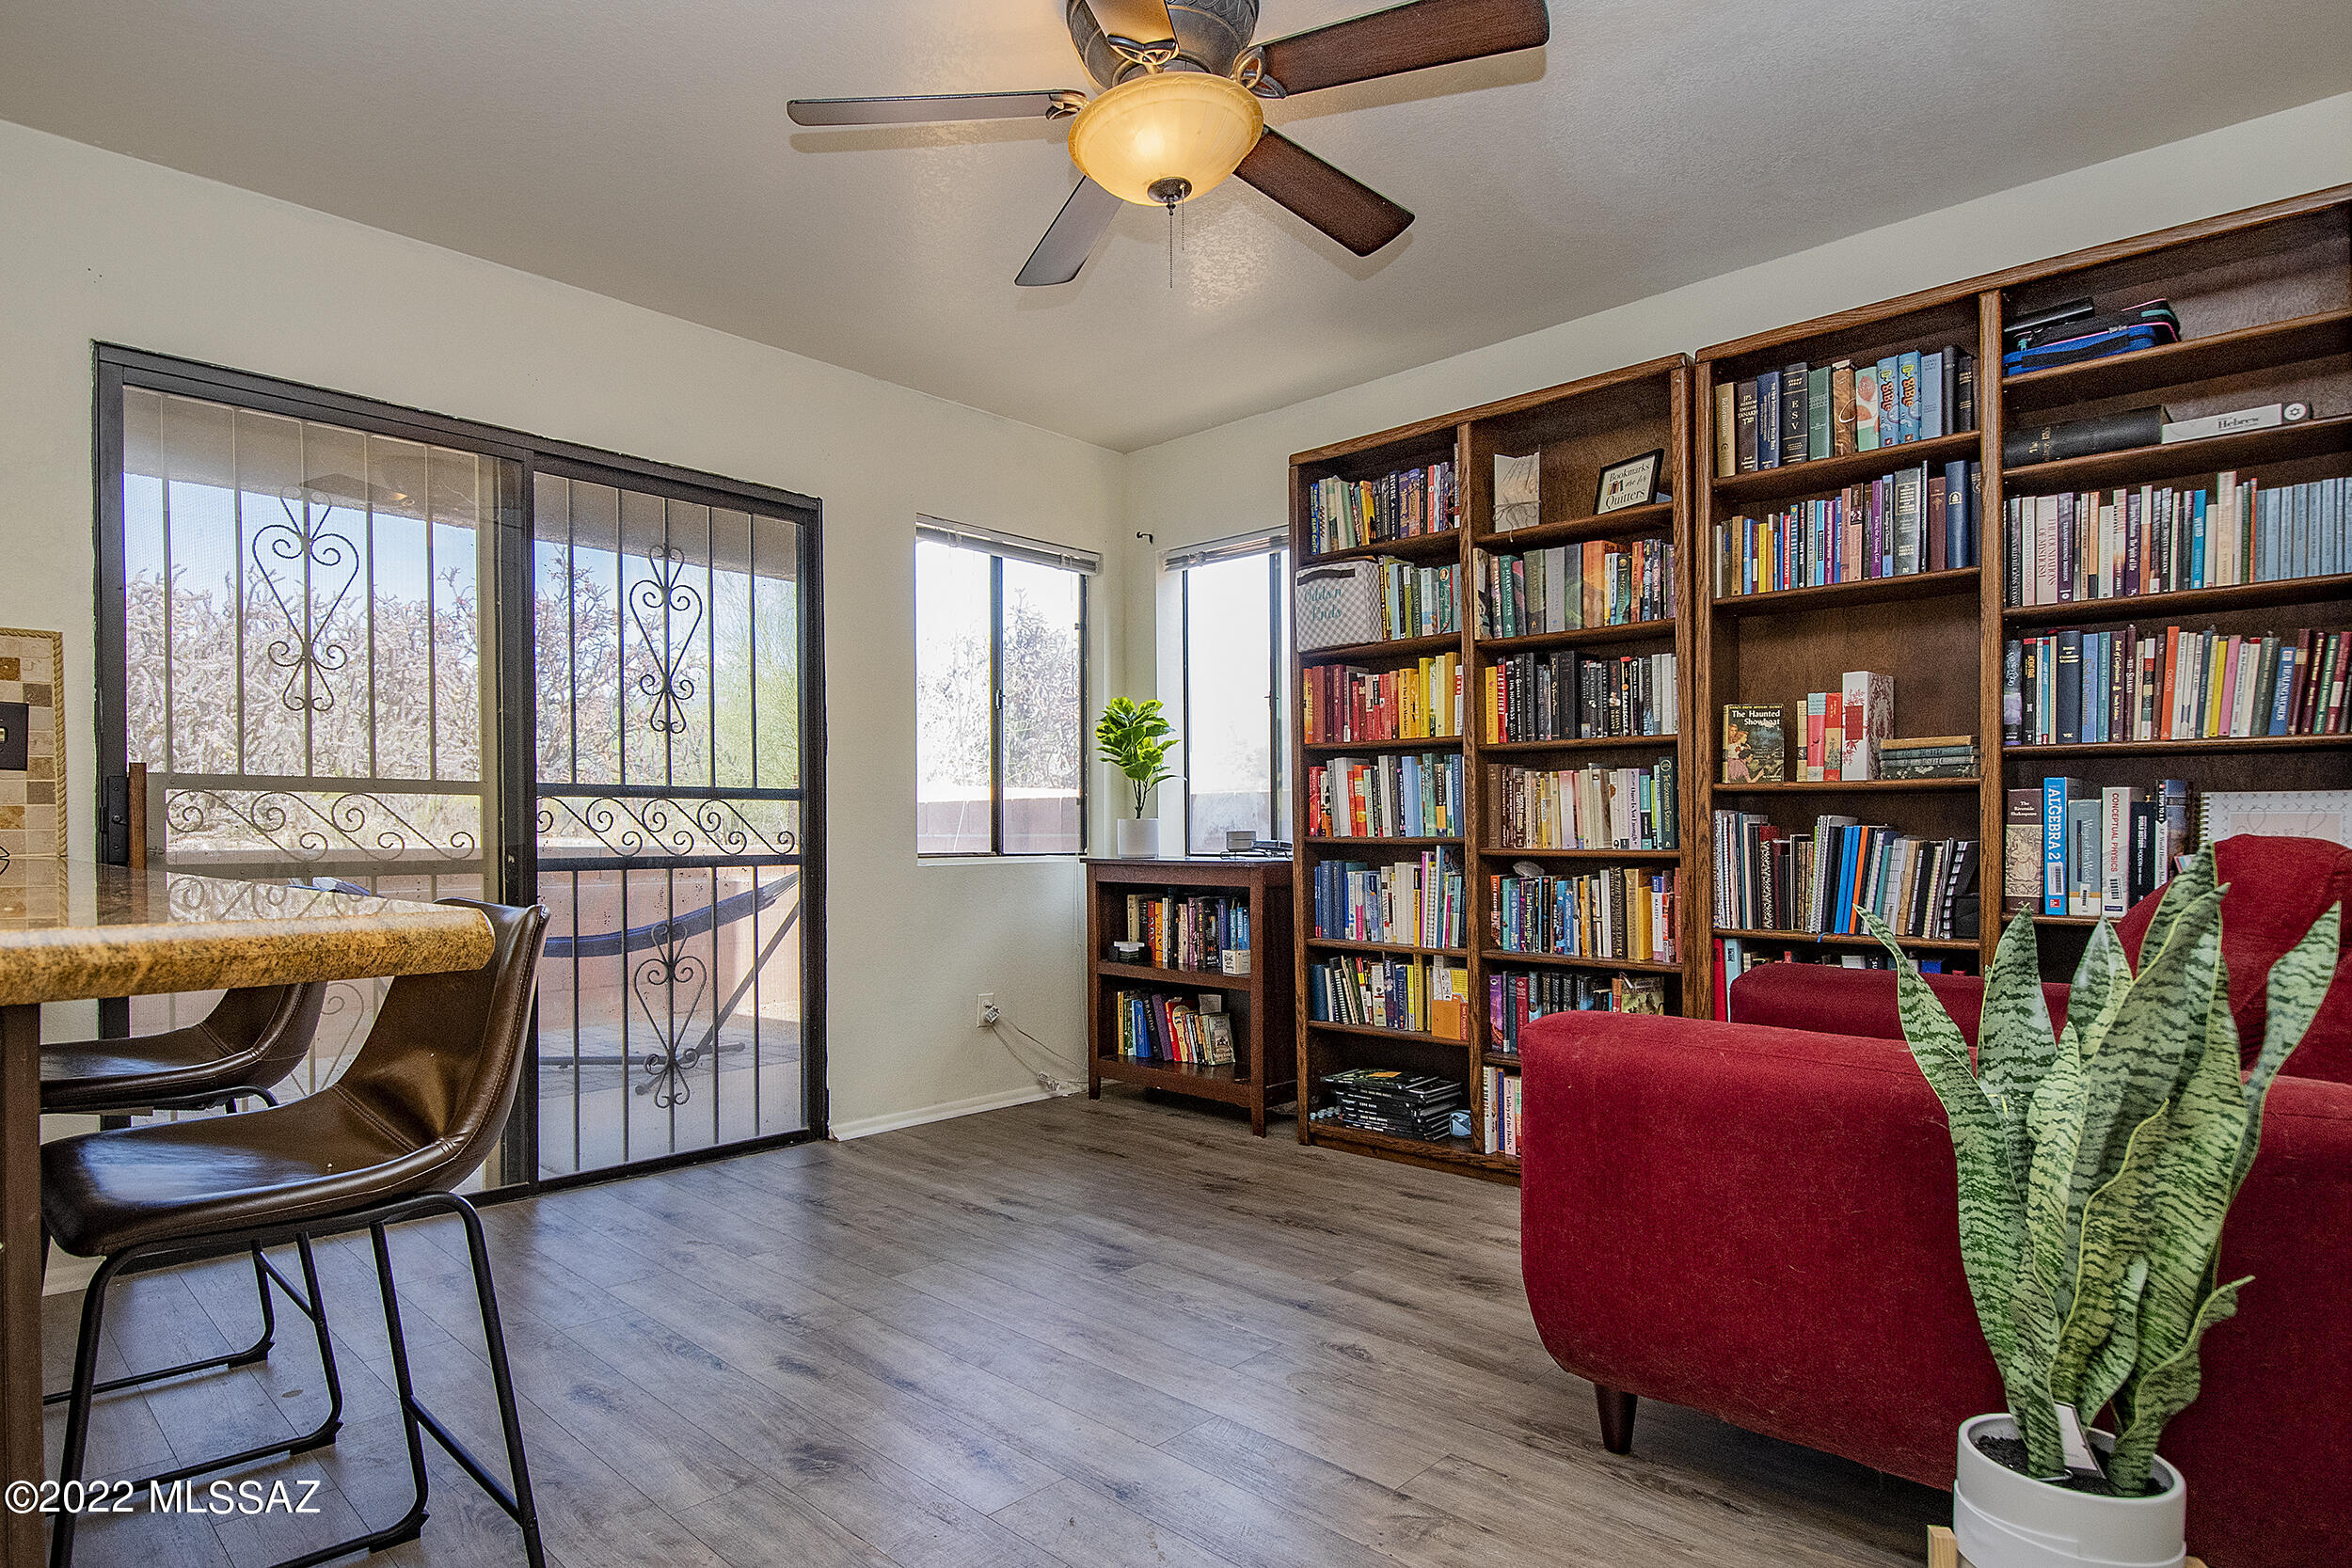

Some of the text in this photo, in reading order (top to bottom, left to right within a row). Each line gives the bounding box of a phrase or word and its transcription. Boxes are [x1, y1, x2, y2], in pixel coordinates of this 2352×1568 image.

[1721, 397, 1729, 437] Reformation
[1609, 464, 1651, 483] Bookmarks
[1605, 489, 1645, 510] Quitters
[2038, 539, 2046, 578] MYSTICISM
[2047, 534, 2056, 586] FOUNDATIONS
[2166, 669, 2174, 692] CHOSEN
[2277, 664, 2293, 721] HEALING WORDS
[1731, 709, 1781, 719] The Haunted
[1743, 718, 1781, 727] Showboat
[2047, 788, 2062, 863] ALGEBRA 2
[2110, 792, 2120, 873] CONCEPTUAL PHYSICS
[2082, 819, 2093, 883] Ways of the World
[1144, 999, 1156, 1032] BRANDO
